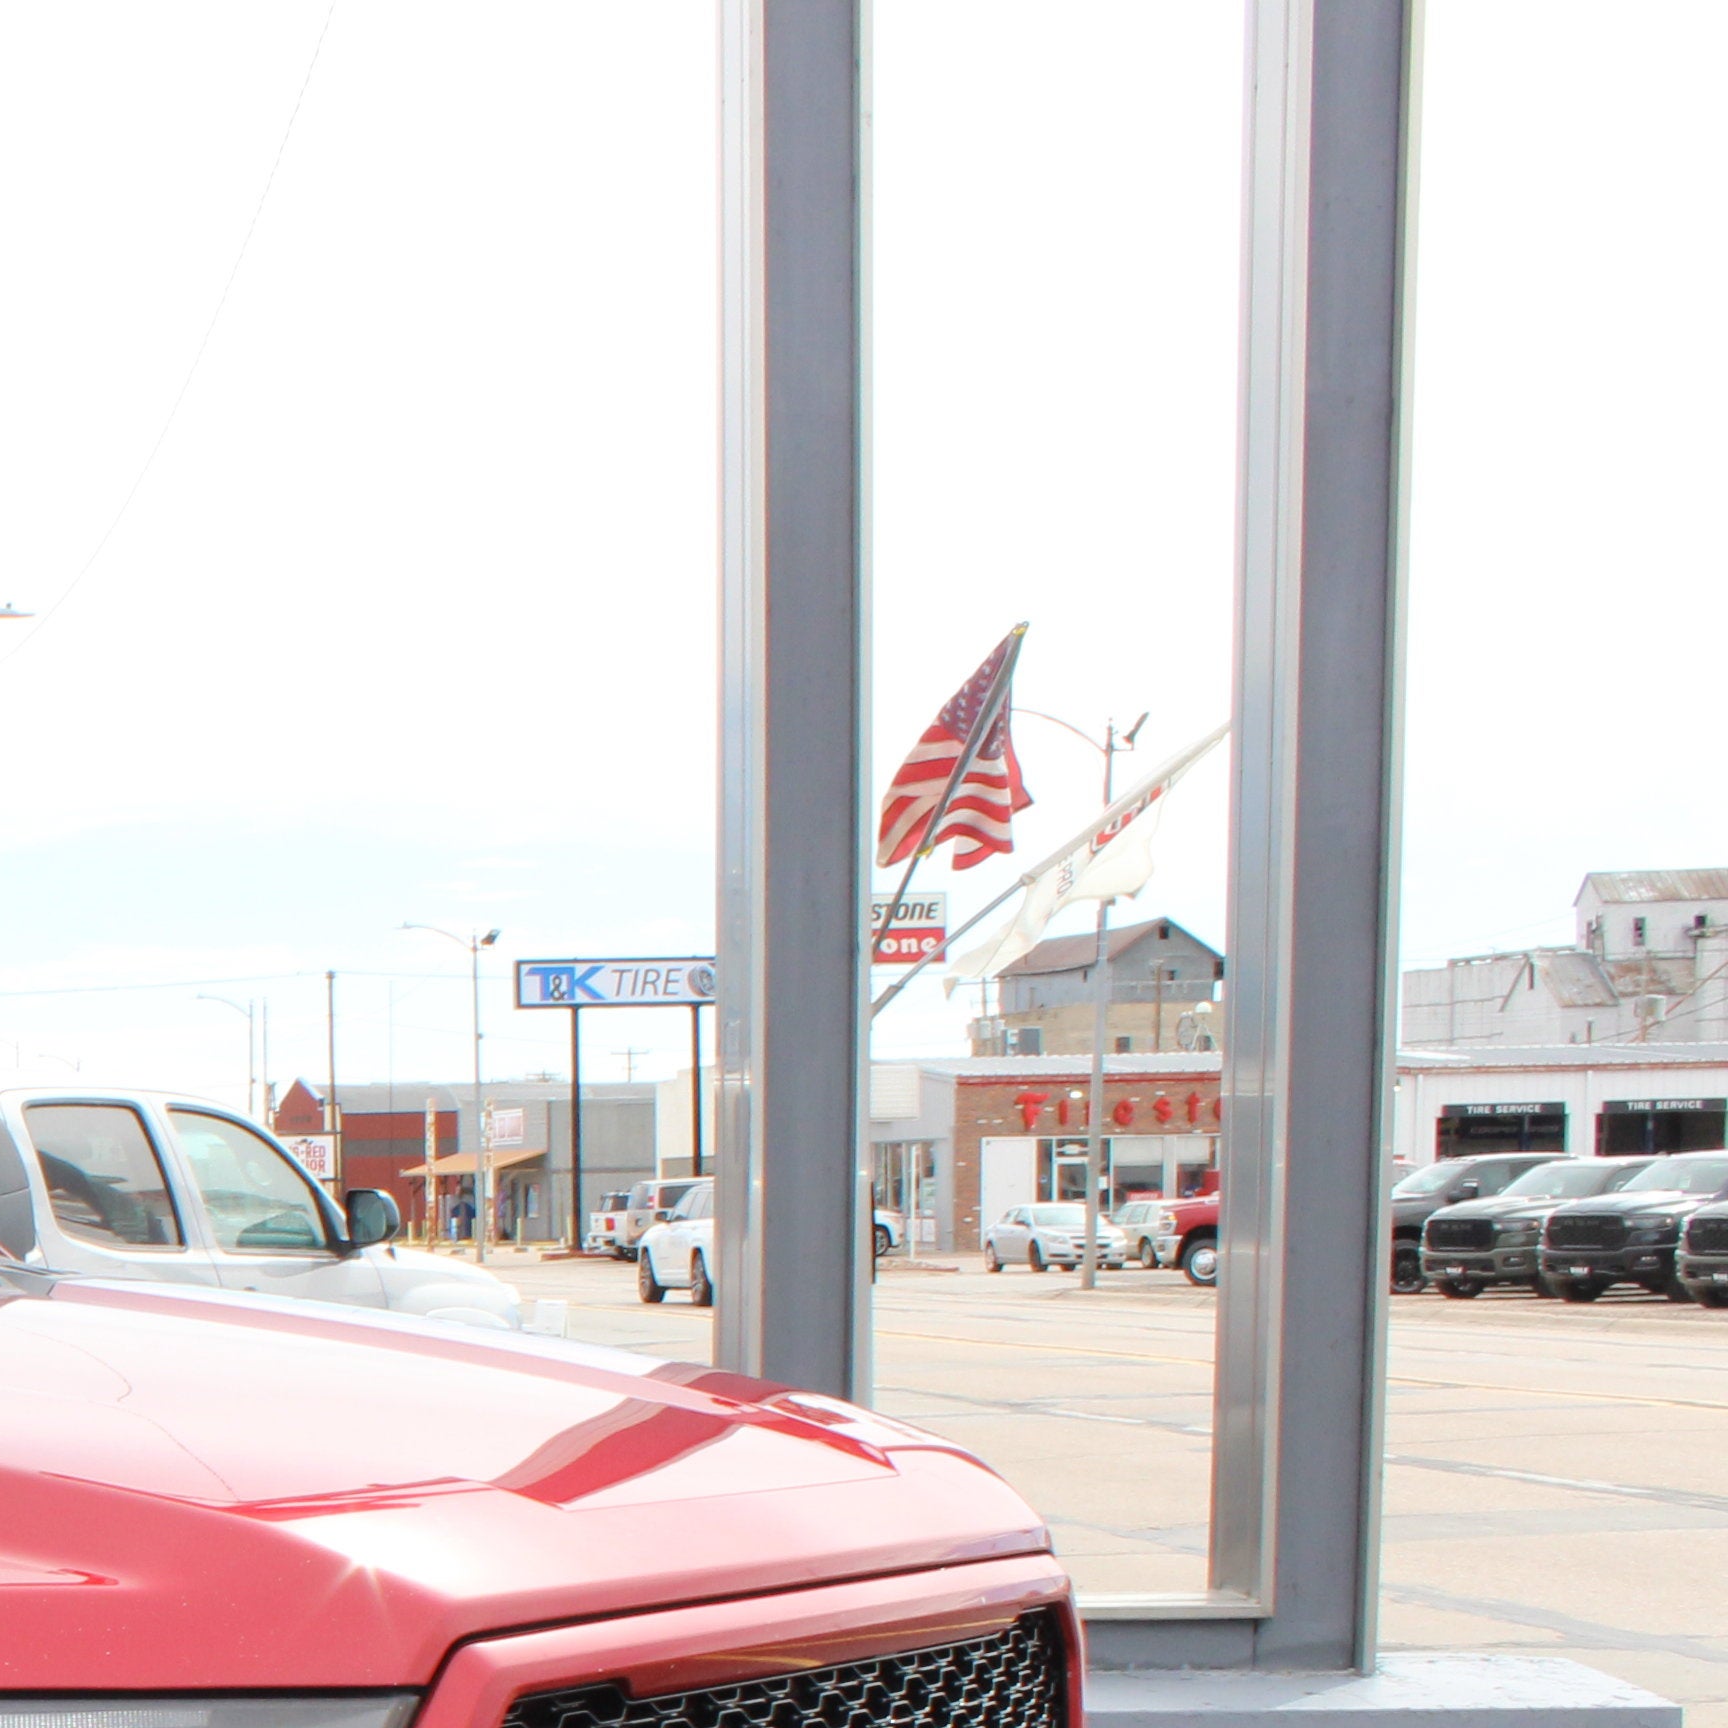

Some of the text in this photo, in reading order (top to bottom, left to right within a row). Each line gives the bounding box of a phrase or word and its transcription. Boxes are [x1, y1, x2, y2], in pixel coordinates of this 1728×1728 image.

[524, 965, 683, 1002] T&K TIRE
[1466, 1104, 1541, 1114] TIRE SERVICE
[1627, 1100, 1703, 1110] TIRE SERVICE
